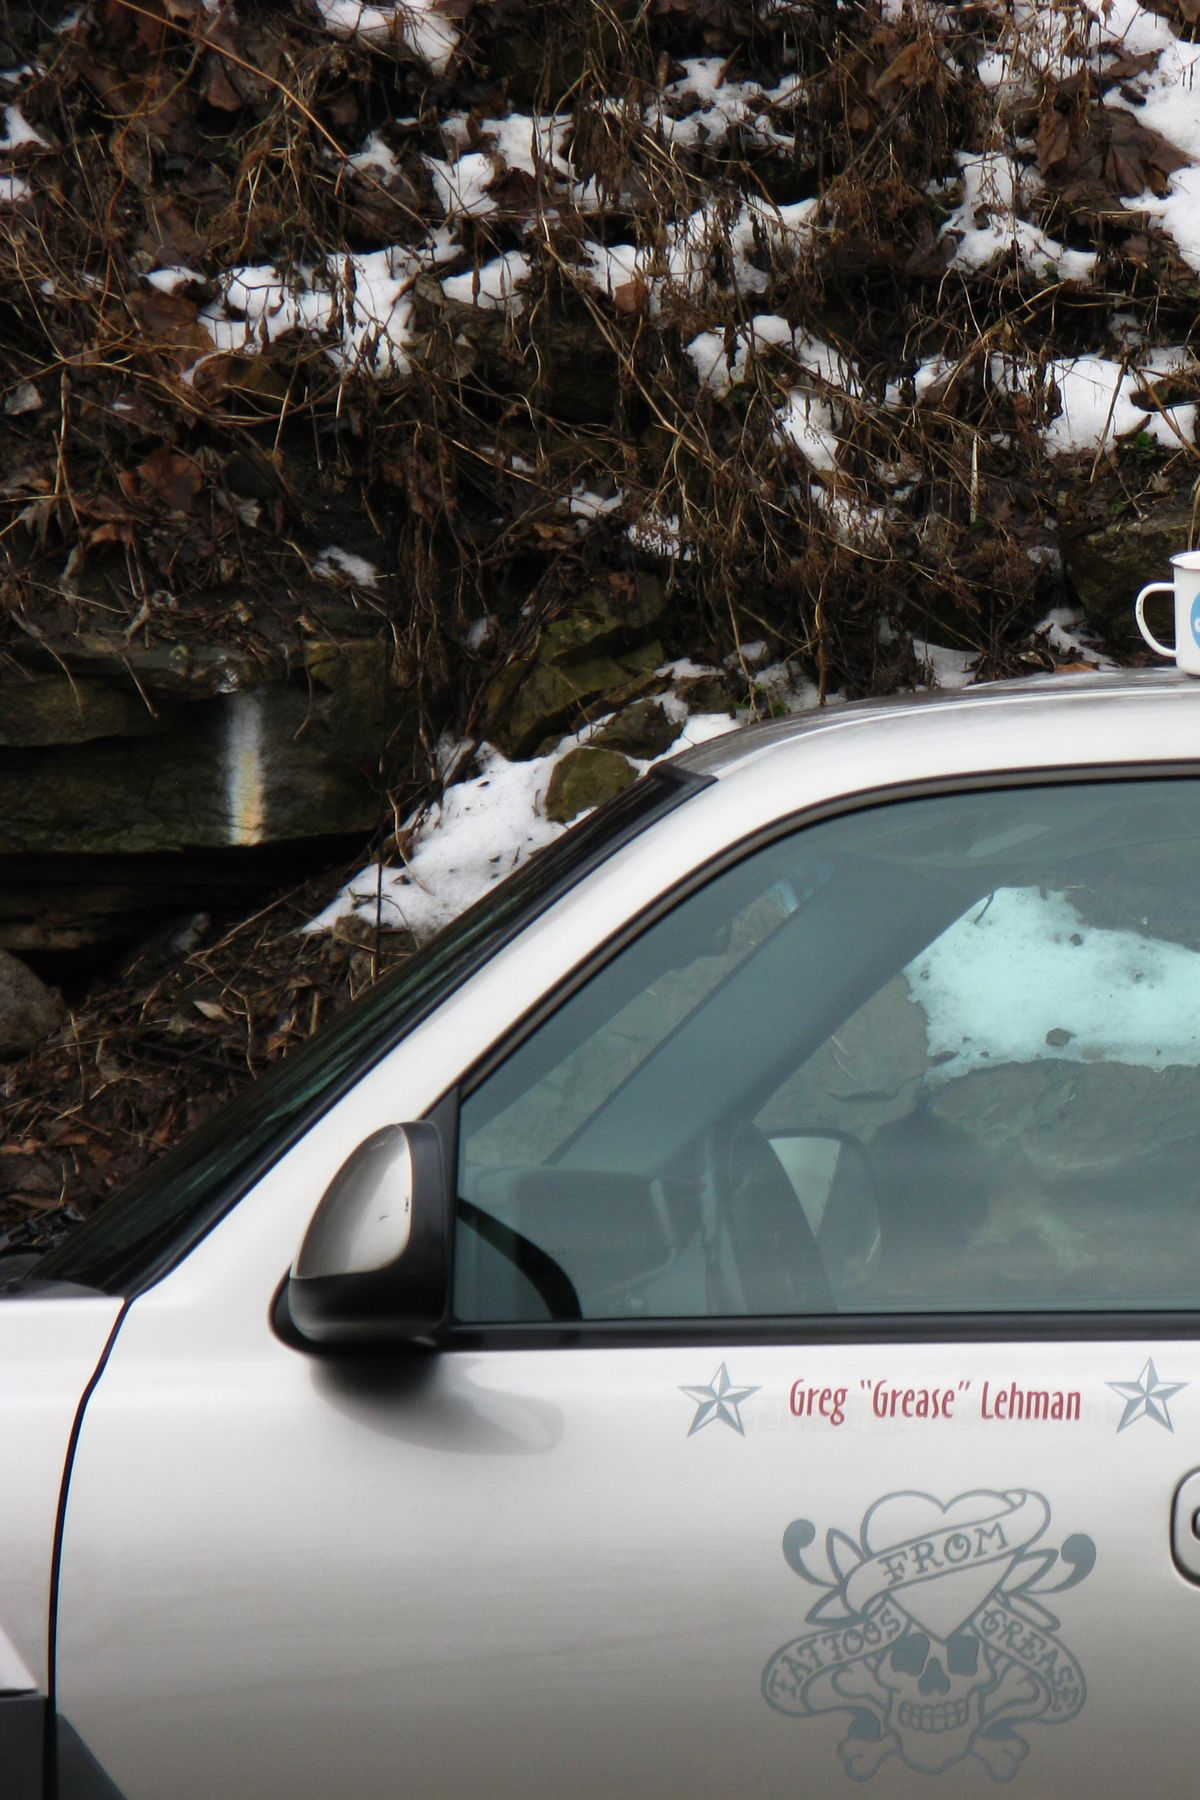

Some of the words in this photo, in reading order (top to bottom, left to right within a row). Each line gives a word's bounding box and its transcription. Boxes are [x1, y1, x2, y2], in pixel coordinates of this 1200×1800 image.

[789, 1379, 848, 1426] Greg
[981, 1381, 1081, 1420] Lehman
[877, 1522, 1010, 1587] FROM
[768, 1607, 902, 1700] TATTOOS
[979, 1608, 1080, 1713] GREASE
